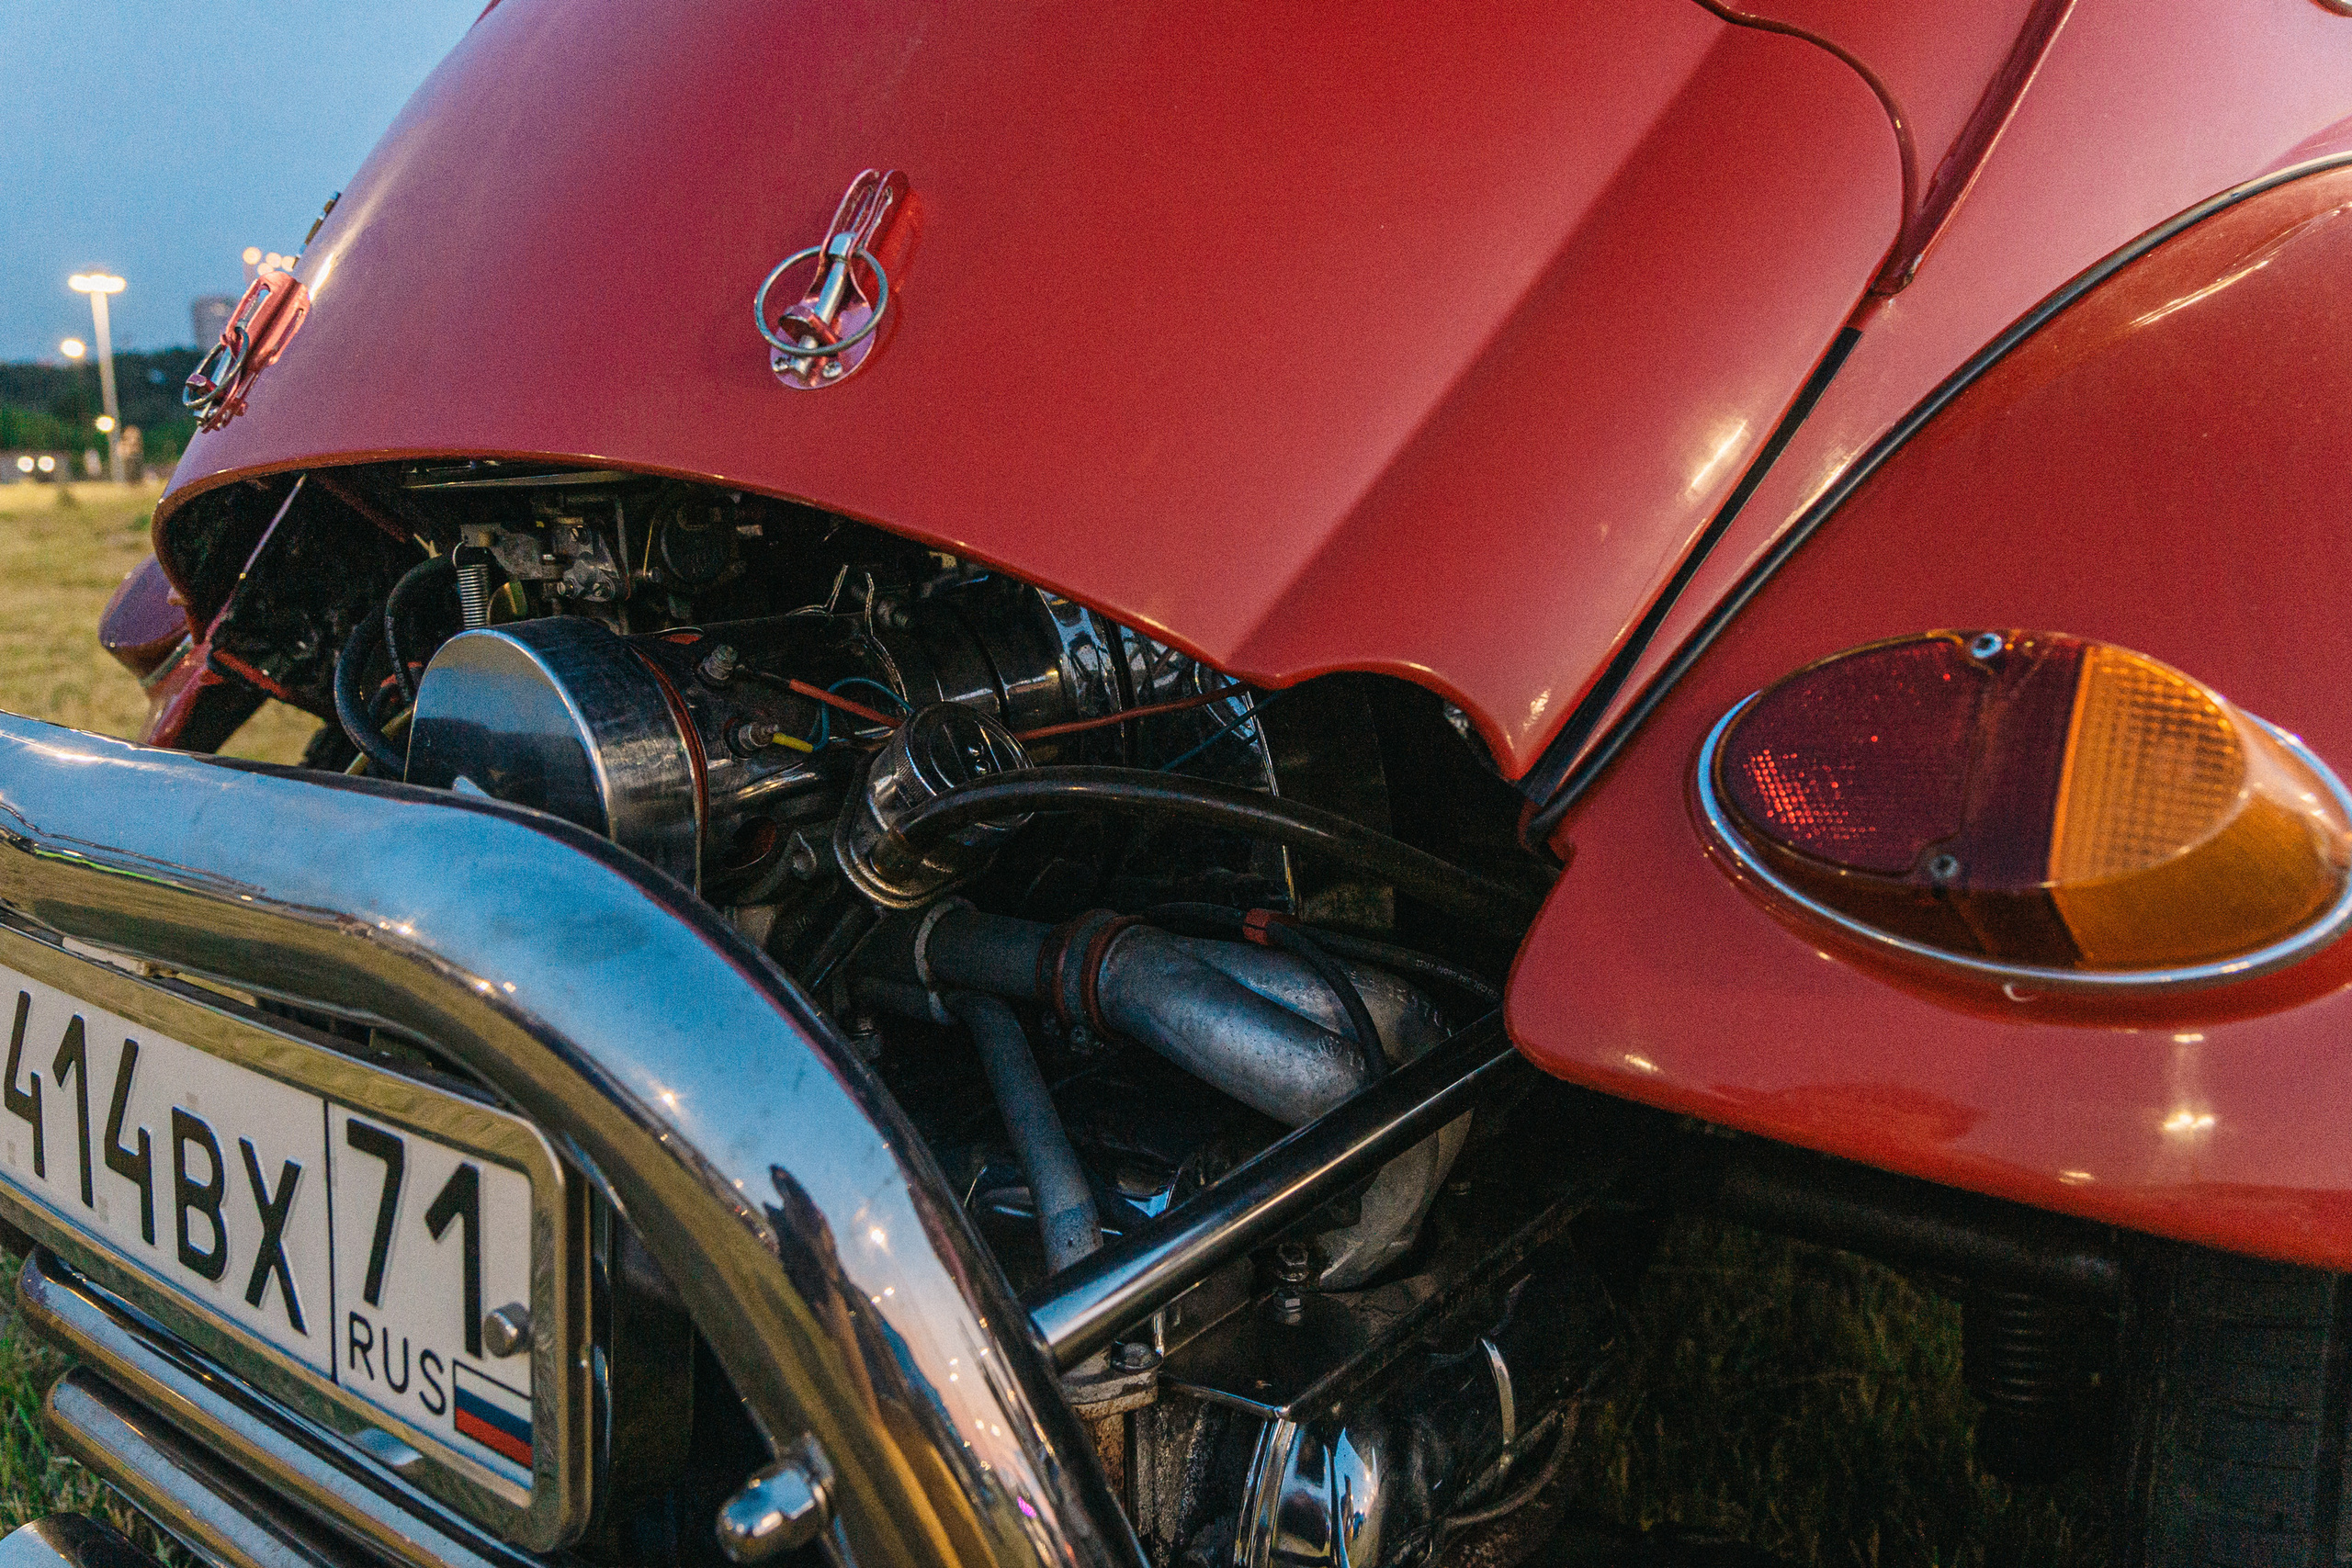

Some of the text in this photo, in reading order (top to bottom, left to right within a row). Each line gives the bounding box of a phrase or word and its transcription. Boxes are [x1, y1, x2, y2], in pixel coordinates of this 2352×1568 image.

[3, 990, 483, 1360] 414BX 71
[348, 1311, 447, 1416] RUS
